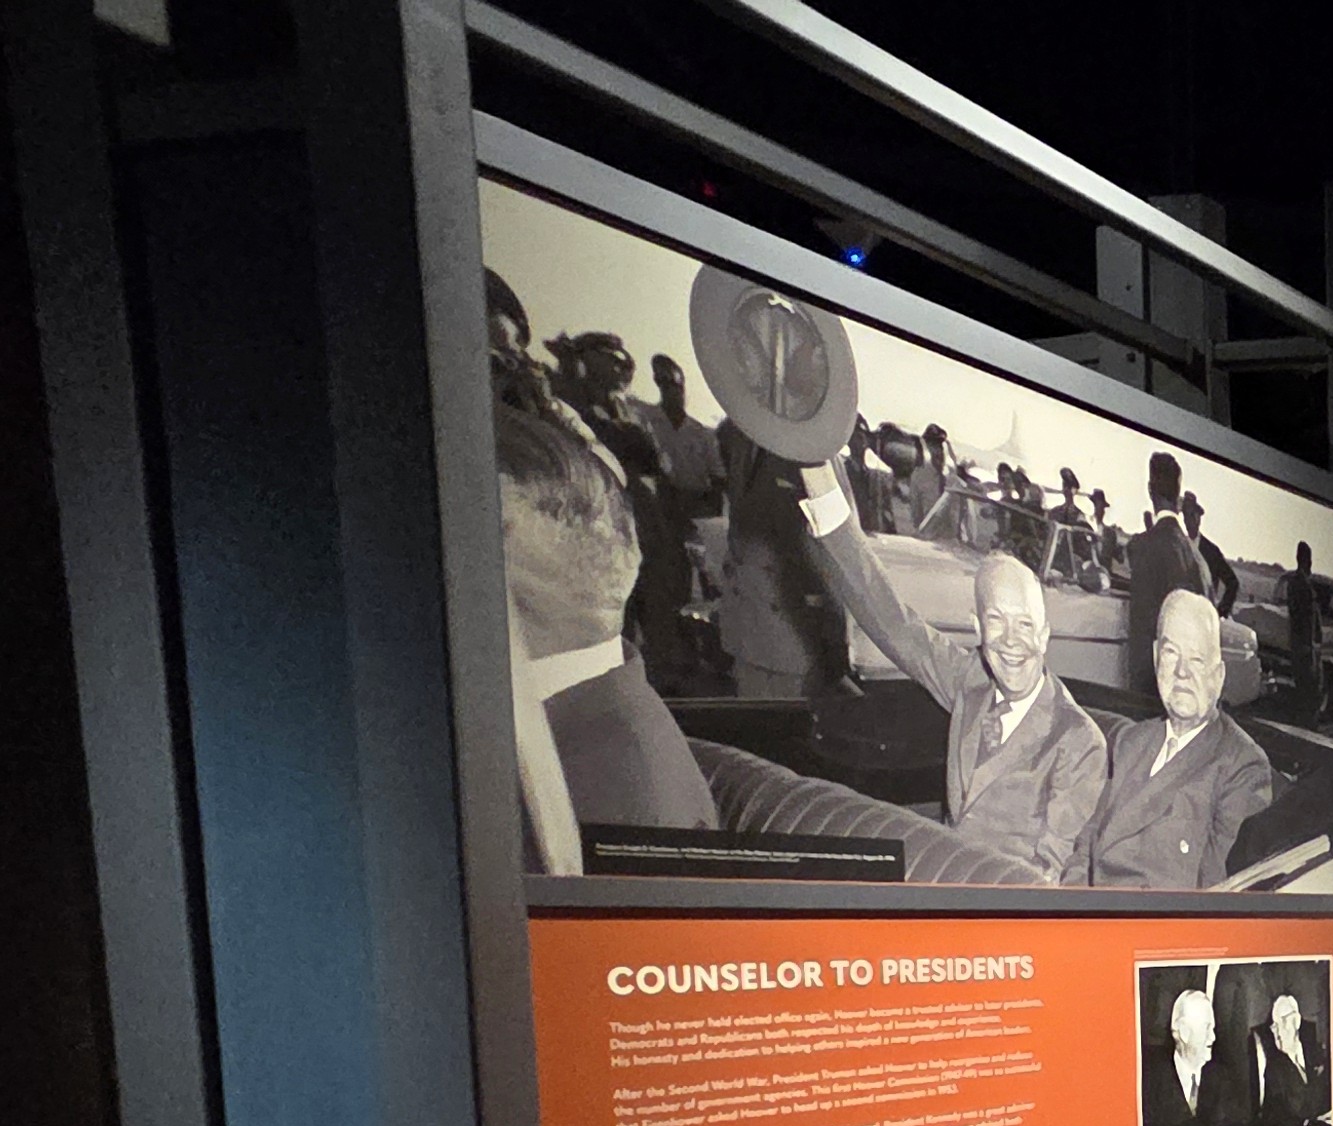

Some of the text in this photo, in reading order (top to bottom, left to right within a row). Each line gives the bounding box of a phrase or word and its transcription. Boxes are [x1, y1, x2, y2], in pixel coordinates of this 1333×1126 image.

[608, 956, 1034, 995] COUNSELOR TO PRESIDENTS
[610, 1022, 654, 1034] Though
[656, 1020, 671, 1030] he
